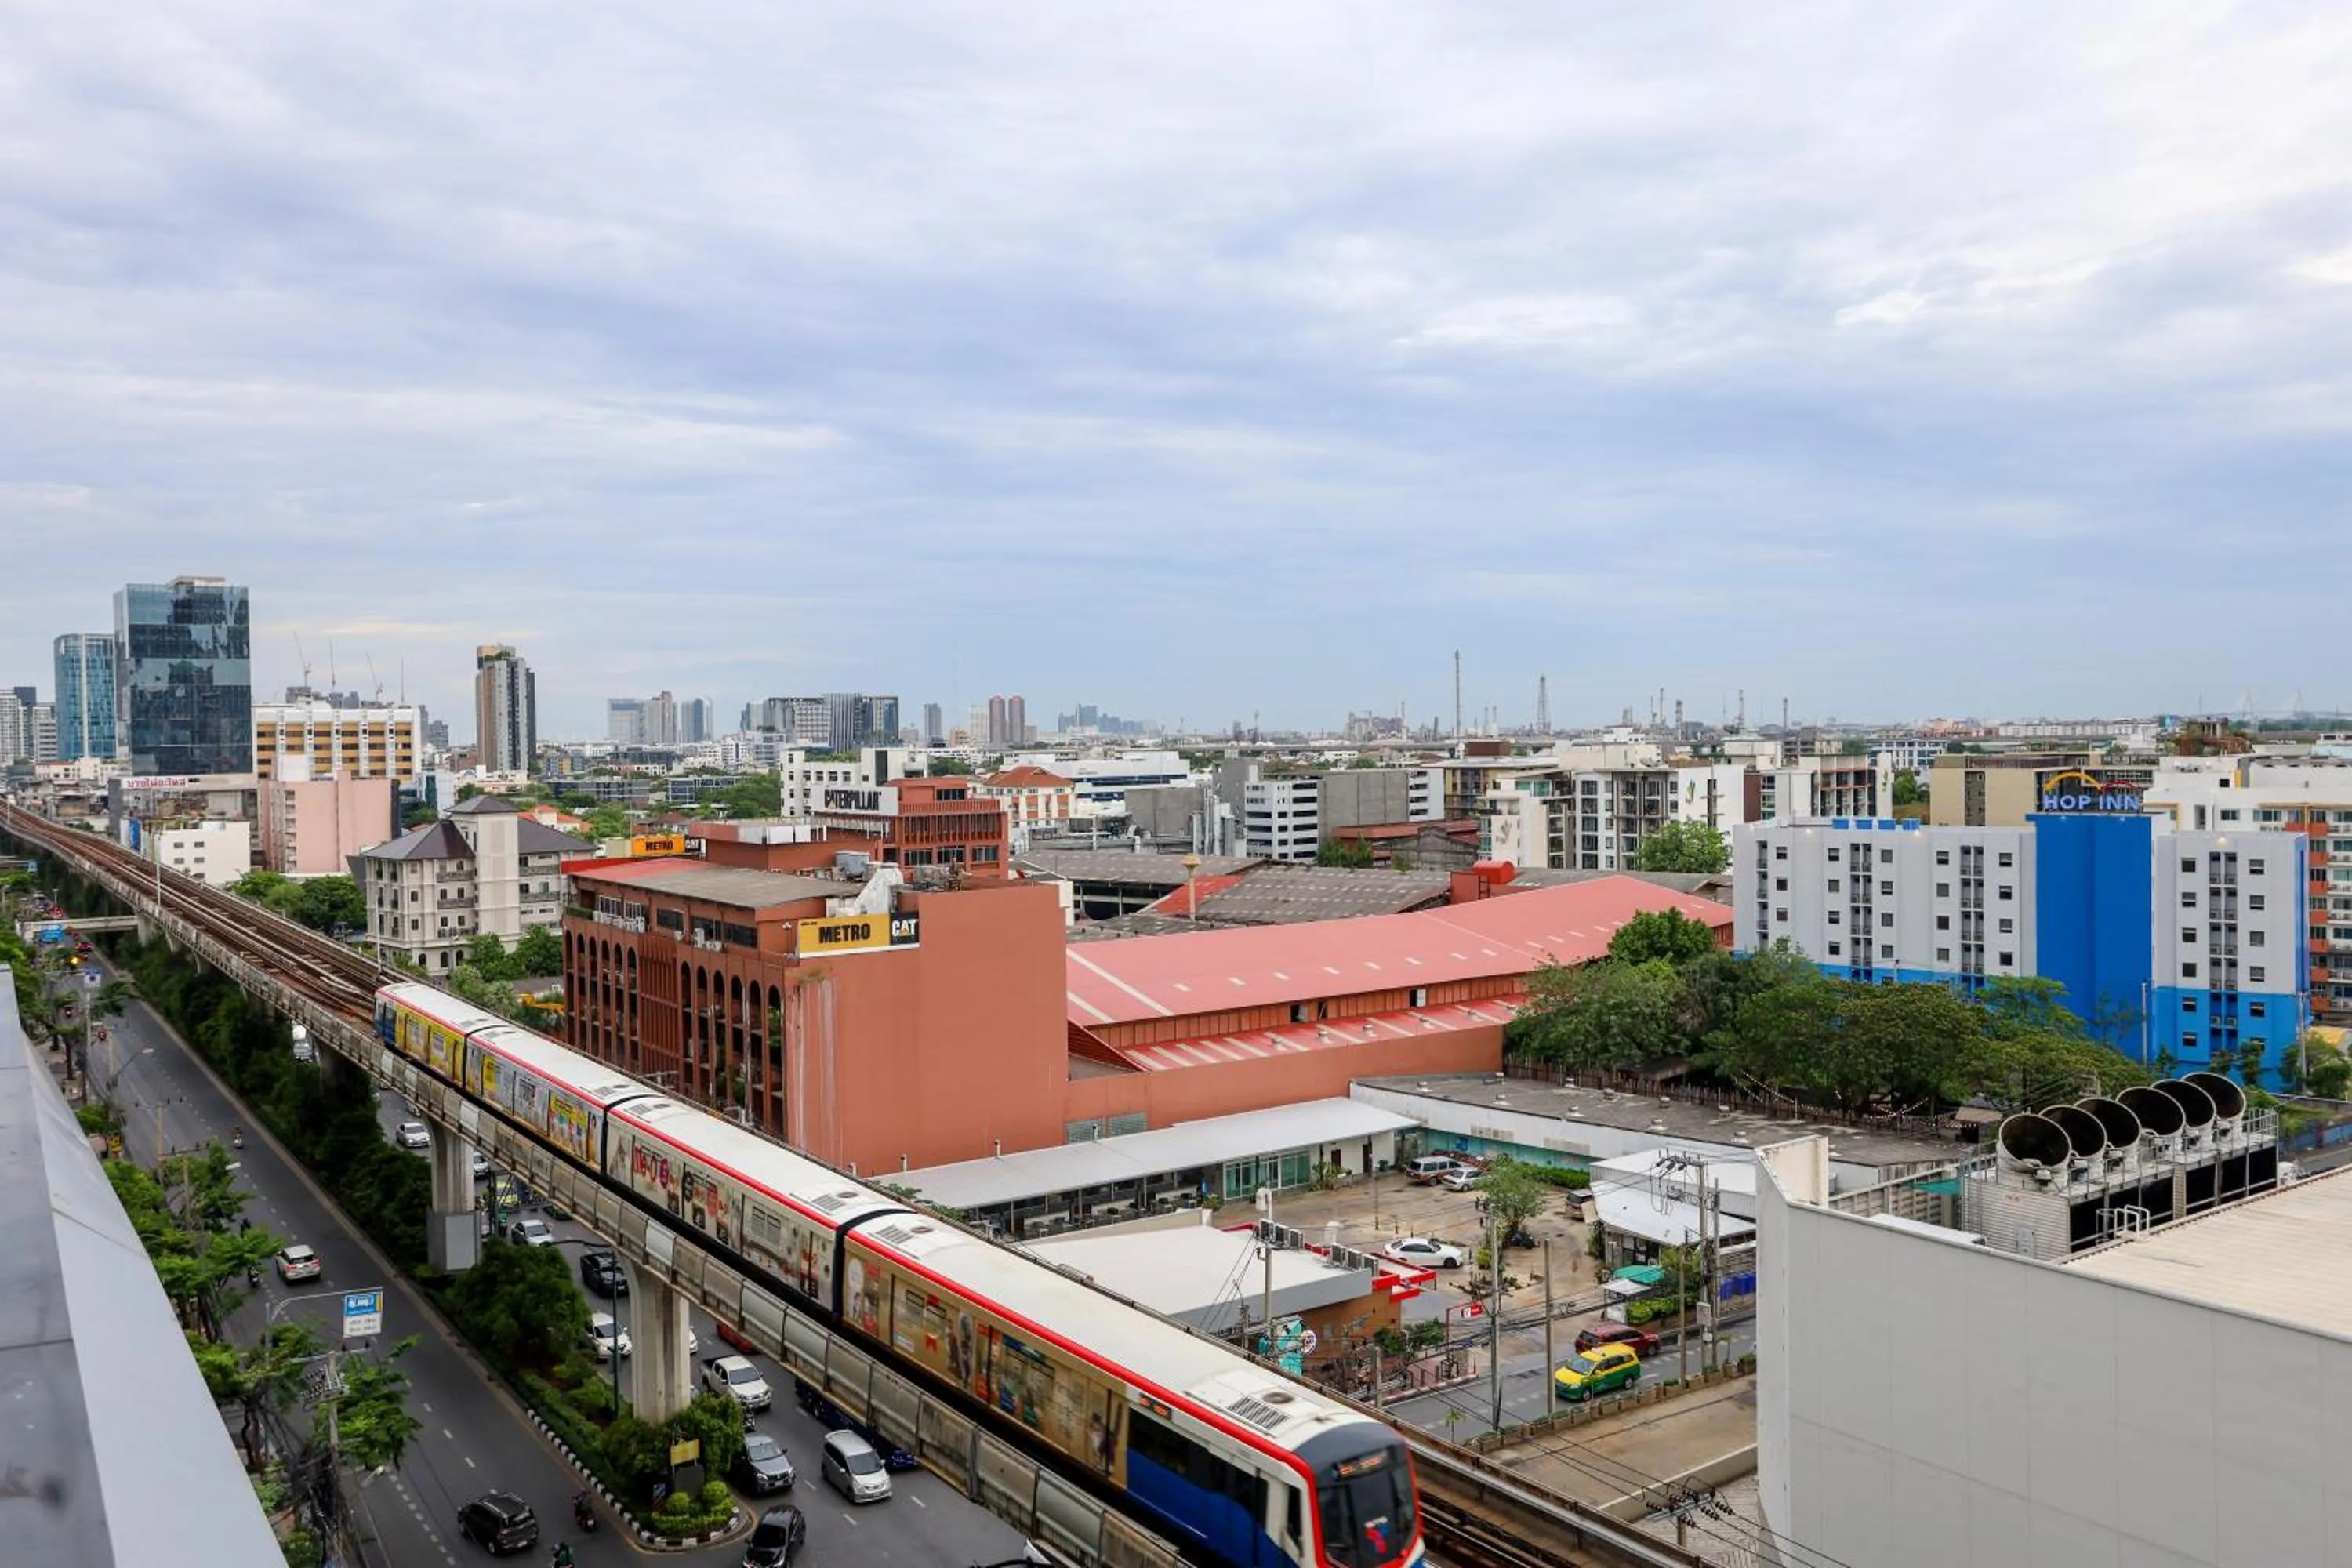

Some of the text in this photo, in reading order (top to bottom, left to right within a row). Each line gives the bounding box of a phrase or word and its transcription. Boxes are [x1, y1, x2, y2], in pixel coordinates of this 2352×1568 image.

[825, 789, 879, 810] CATERPILLAR
[2043, 794, 2139, 810] HOP INN
[645, 841, 673, 851] METRO
[686, 839, 699, 849] CAT
[818, 923, 871, 944] METRO
[892, 920, 917, 937] CAT
